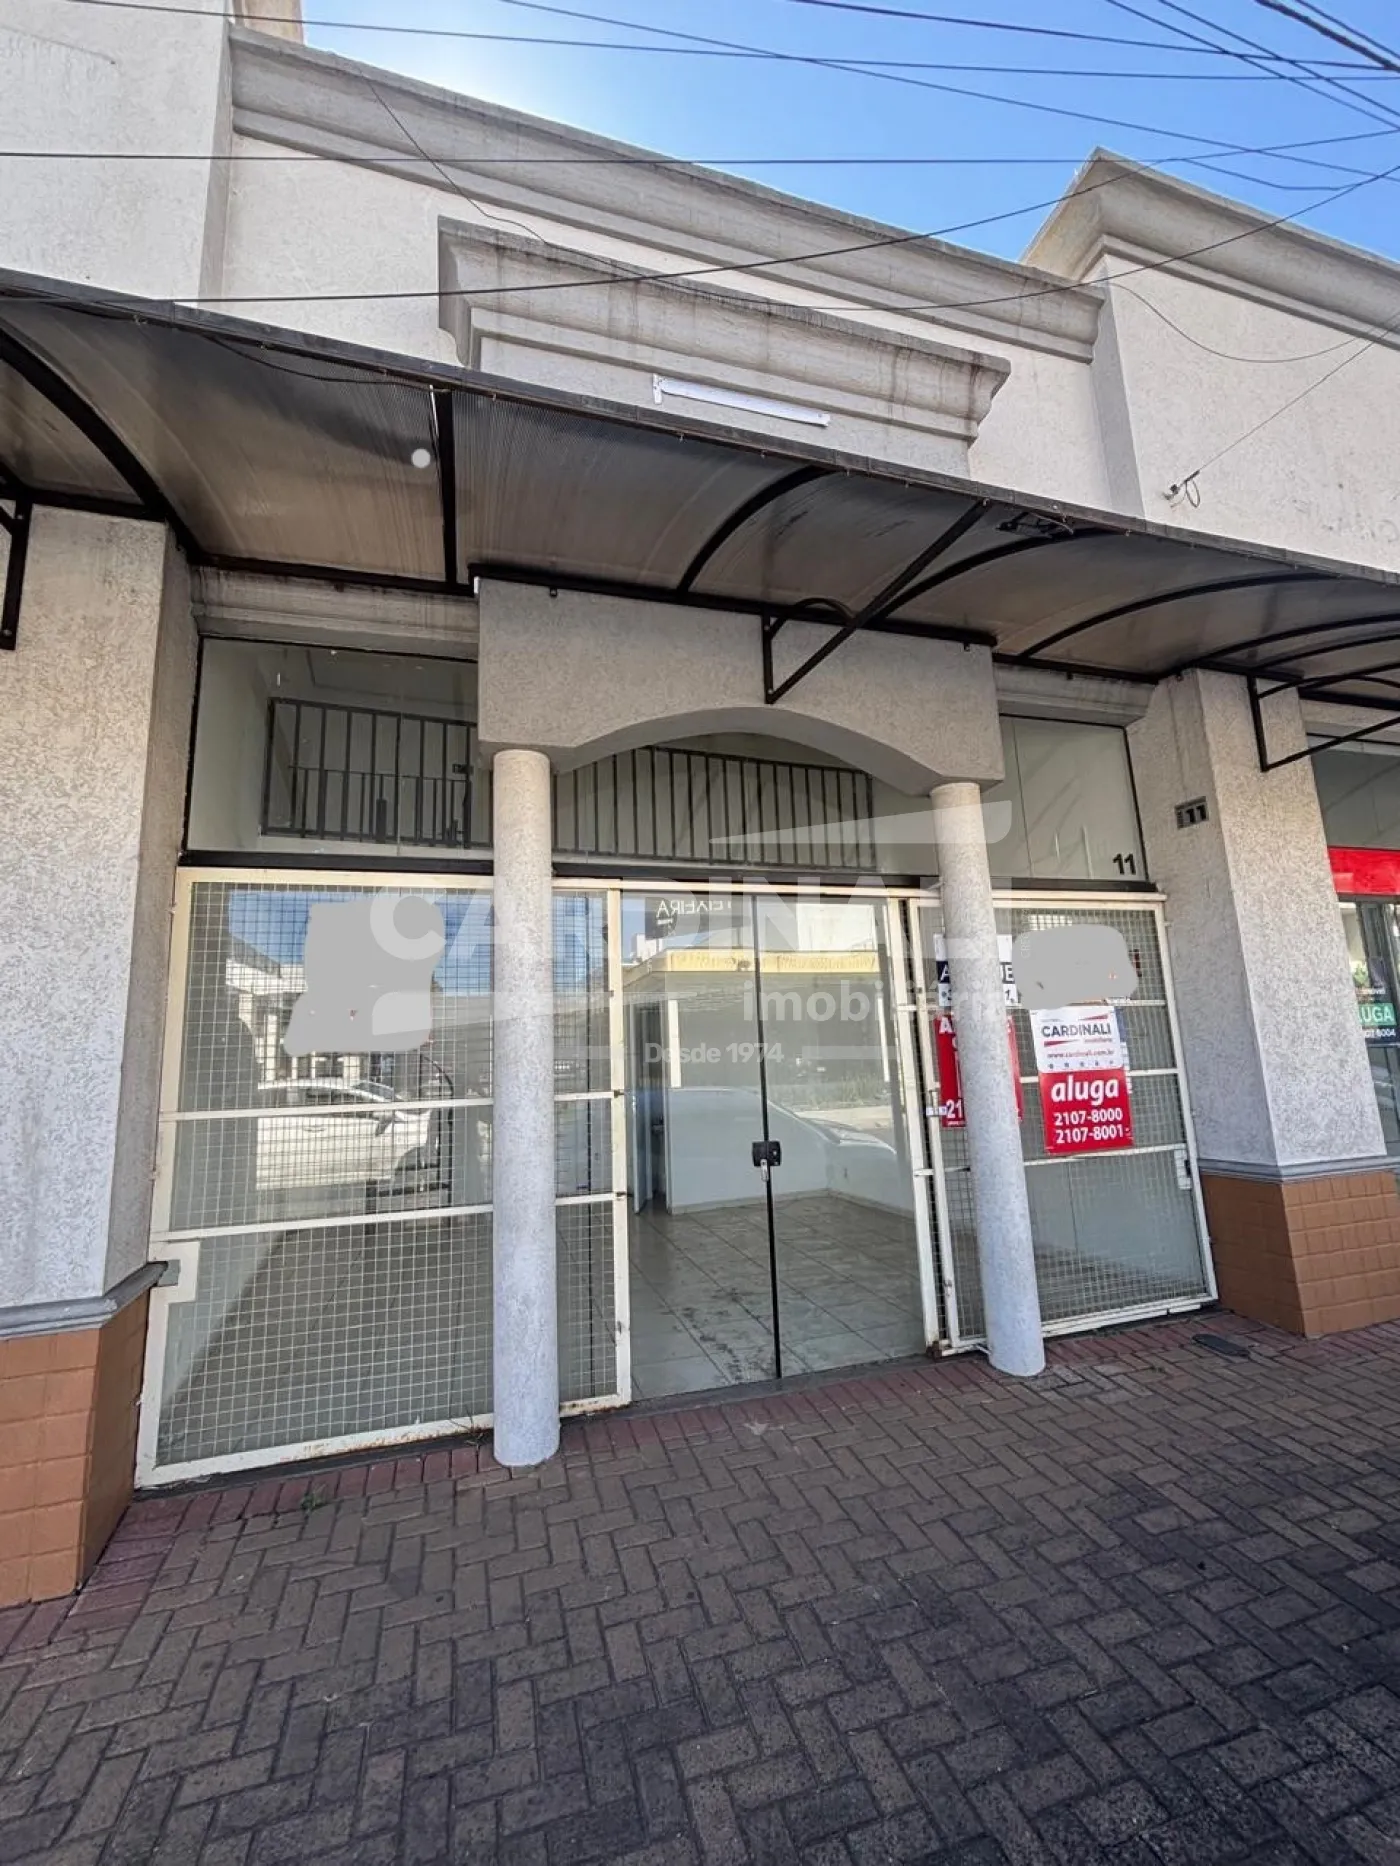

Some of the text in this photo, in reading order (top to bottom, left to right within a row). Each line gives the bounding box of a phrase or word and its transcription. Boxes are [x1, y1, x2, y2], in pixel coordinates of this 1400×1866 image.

[1185, 804, 1207, 823] 11
[1112, 853, 1136, 875] 11
[1042, 1023, 1112, 1037] CARDINALI
[1051, 1075, 1119, 1106] aluga
[1054, 1108, 1123, 1126] 2107-8000
[1056, 1124, 1123, 1144] 2107-8001
